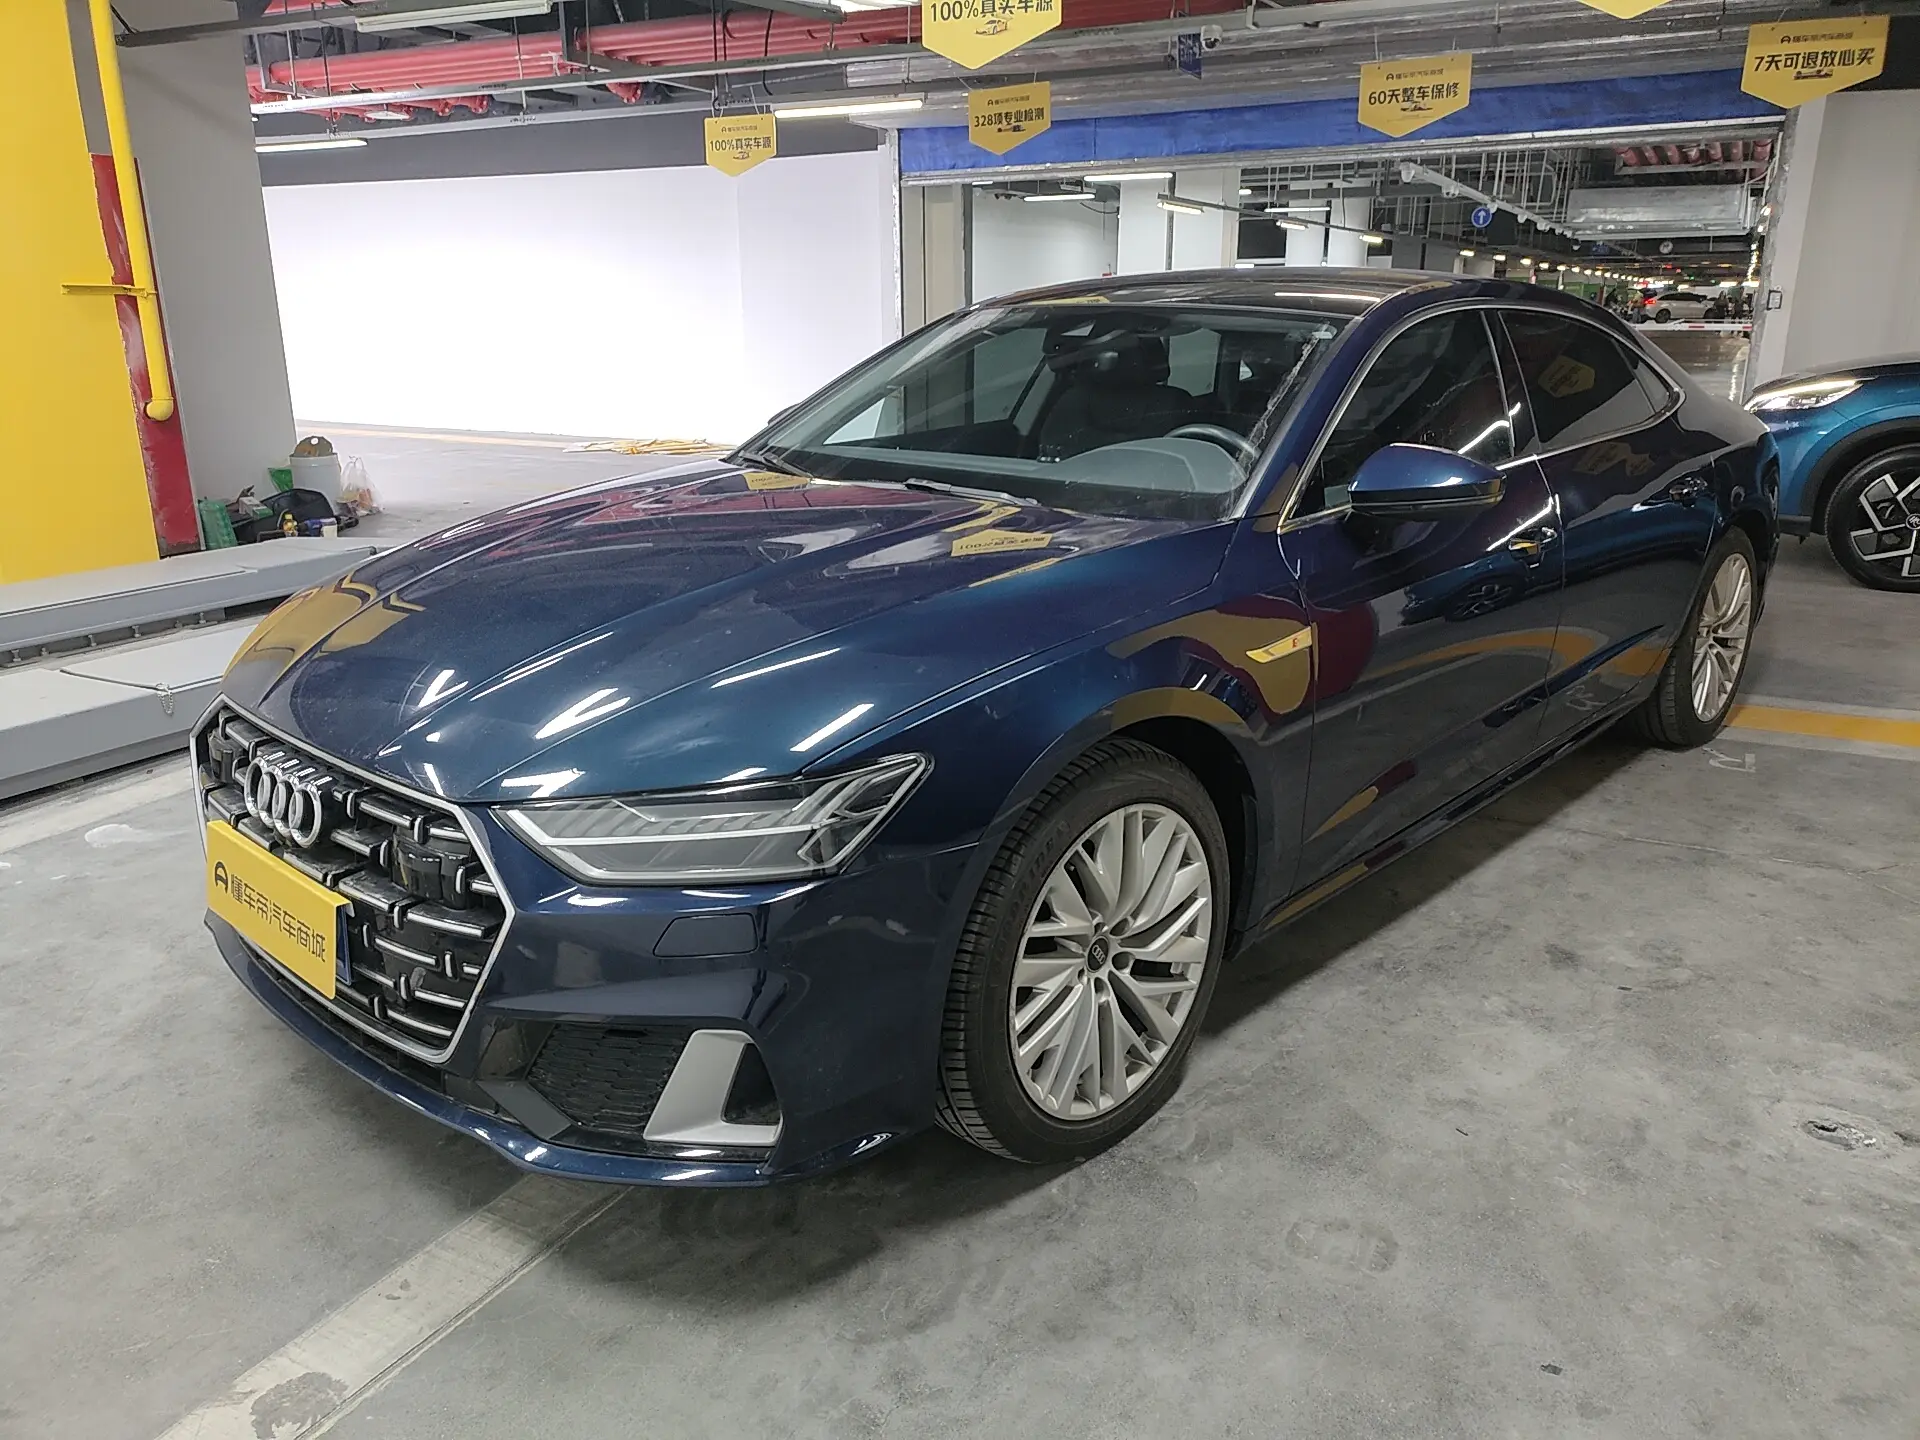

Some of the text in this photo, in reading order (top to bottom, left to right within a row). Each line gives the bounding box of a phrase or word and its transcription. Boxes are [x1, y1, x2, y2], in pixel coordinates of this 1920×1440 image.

[1753, 48, 1875, 71] 7天可退放心买
[1368, 82, 1459, 105] 60天整车保修
[974, 107, 1045, 127] 328项专业检测
[710, 136, 772, 152] 100%真实车源
[231, 874, 326, 962] 懂车帝汽车商城
